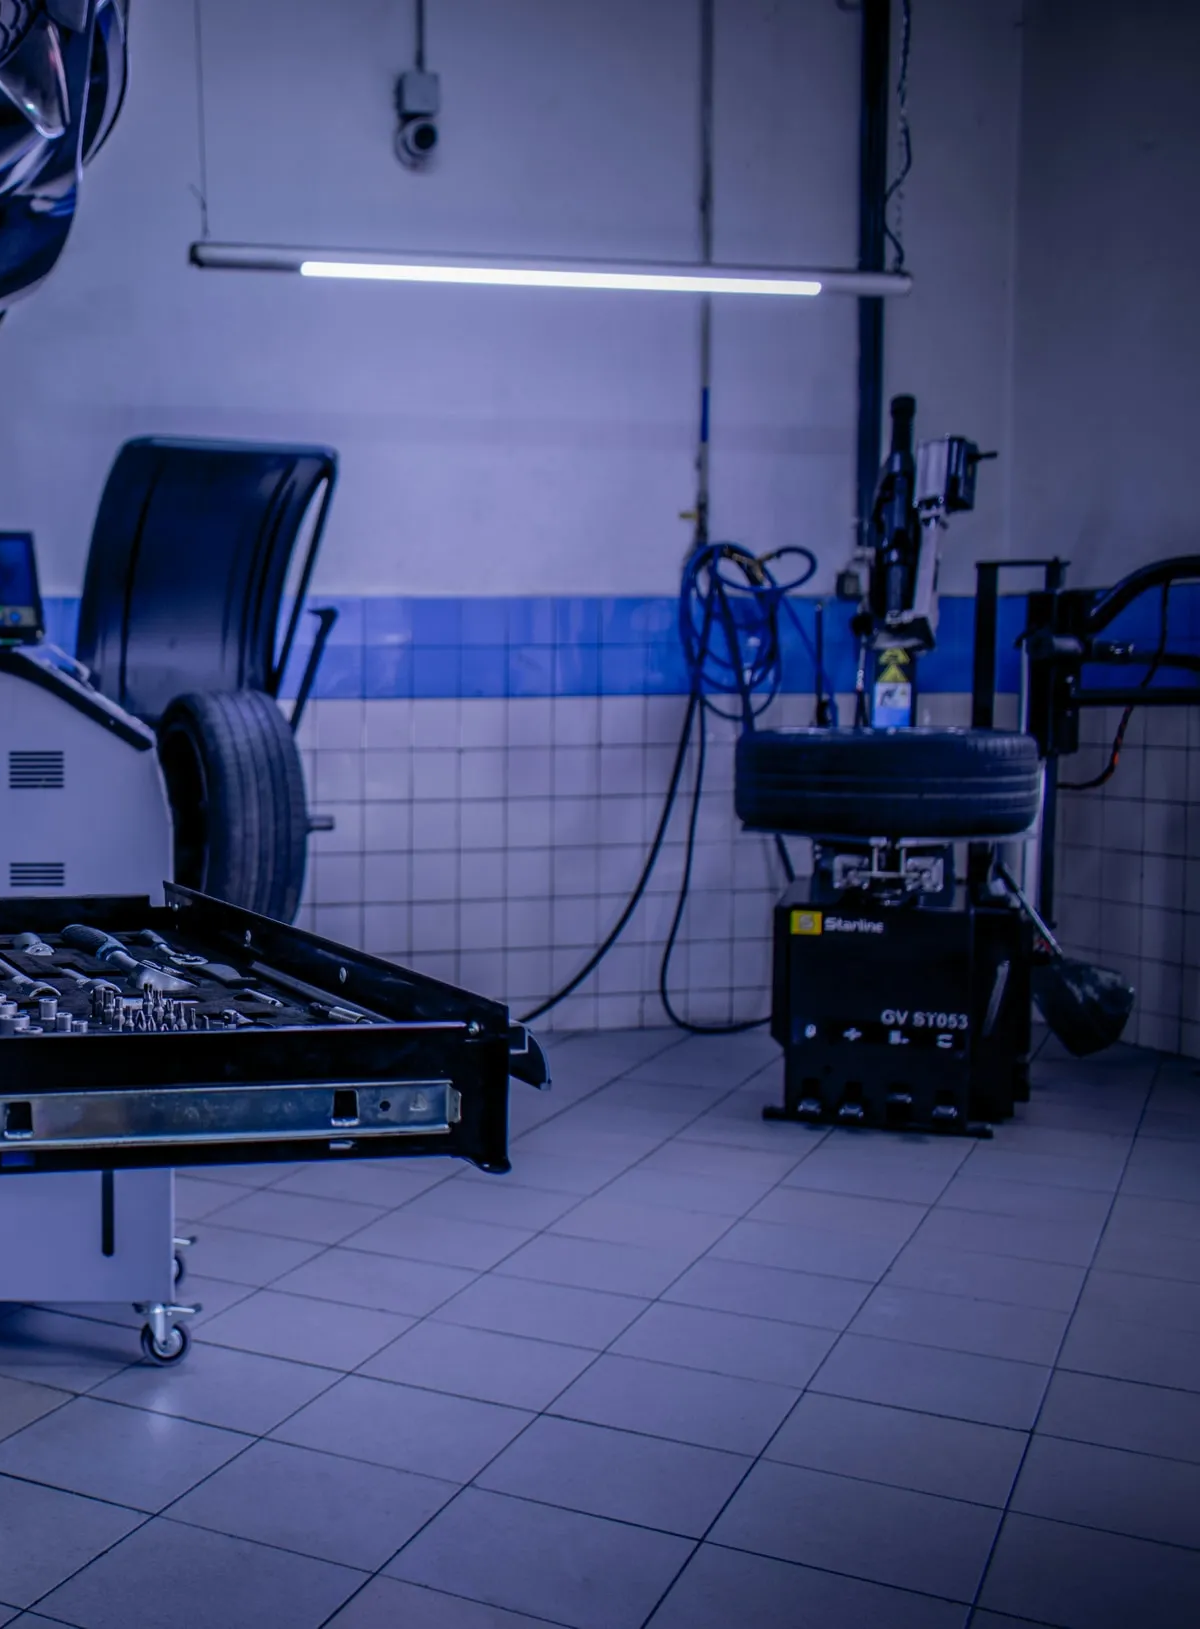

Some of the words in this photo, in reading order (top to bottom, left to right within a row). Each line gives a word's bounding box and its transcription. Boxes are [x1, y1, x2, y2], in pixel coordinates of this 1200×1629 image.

[824, 916, 884, 934] Starline
[881, 1009, 909, 1026] GV
[912, 1011, 969, 1030] ST053
